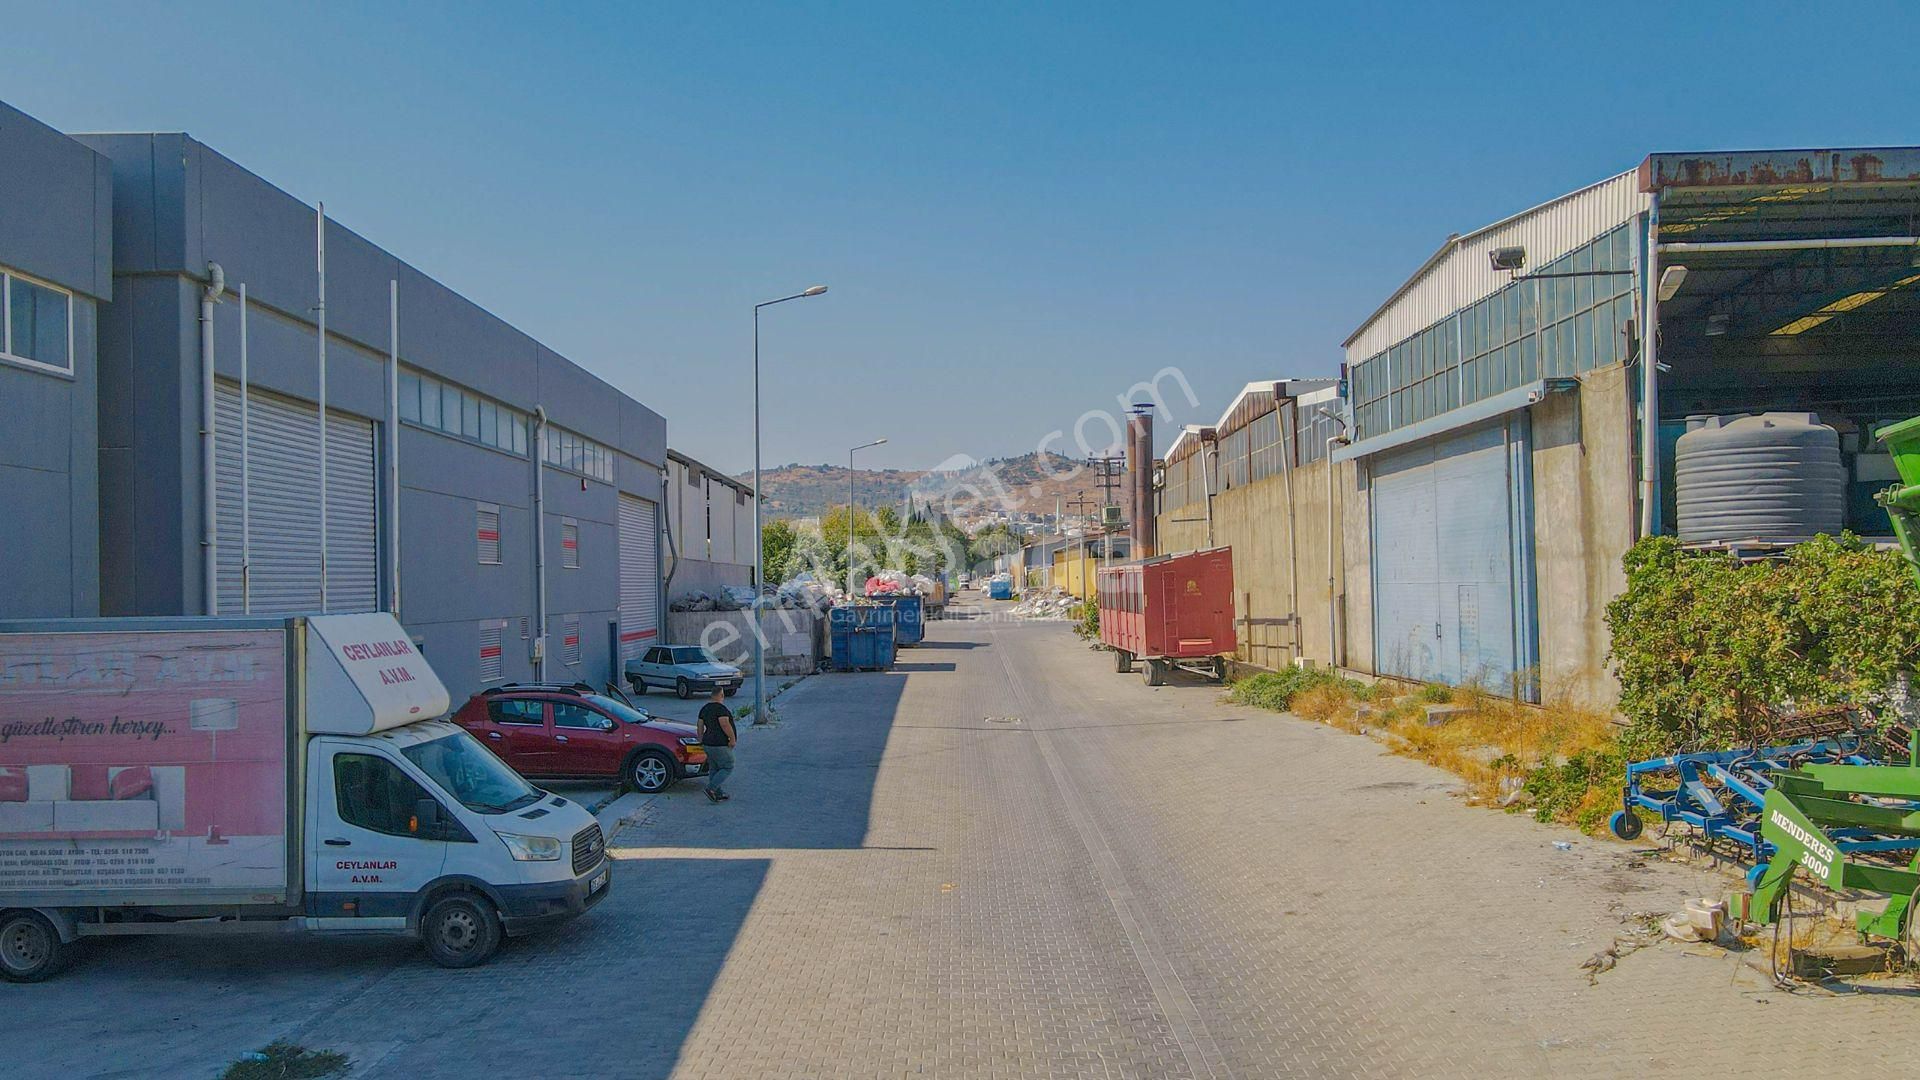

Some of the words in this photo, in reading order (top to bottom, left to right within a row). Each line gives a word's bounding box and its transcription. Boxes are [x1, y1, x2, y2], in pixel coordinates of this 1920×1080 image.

[342, 640, 413, 661] CEYLANLAR
[379, 667, 416, 685] A.V.M.
[2, 716, 105, 742] güzelleştiren
[1770, 810, 1834, 863] MENDERES
[336, 861, 398, 870] CEYLANLAR
[1801, 851, 1829, 879] 3000
[352, 875, 383, 883] A.V.M.
